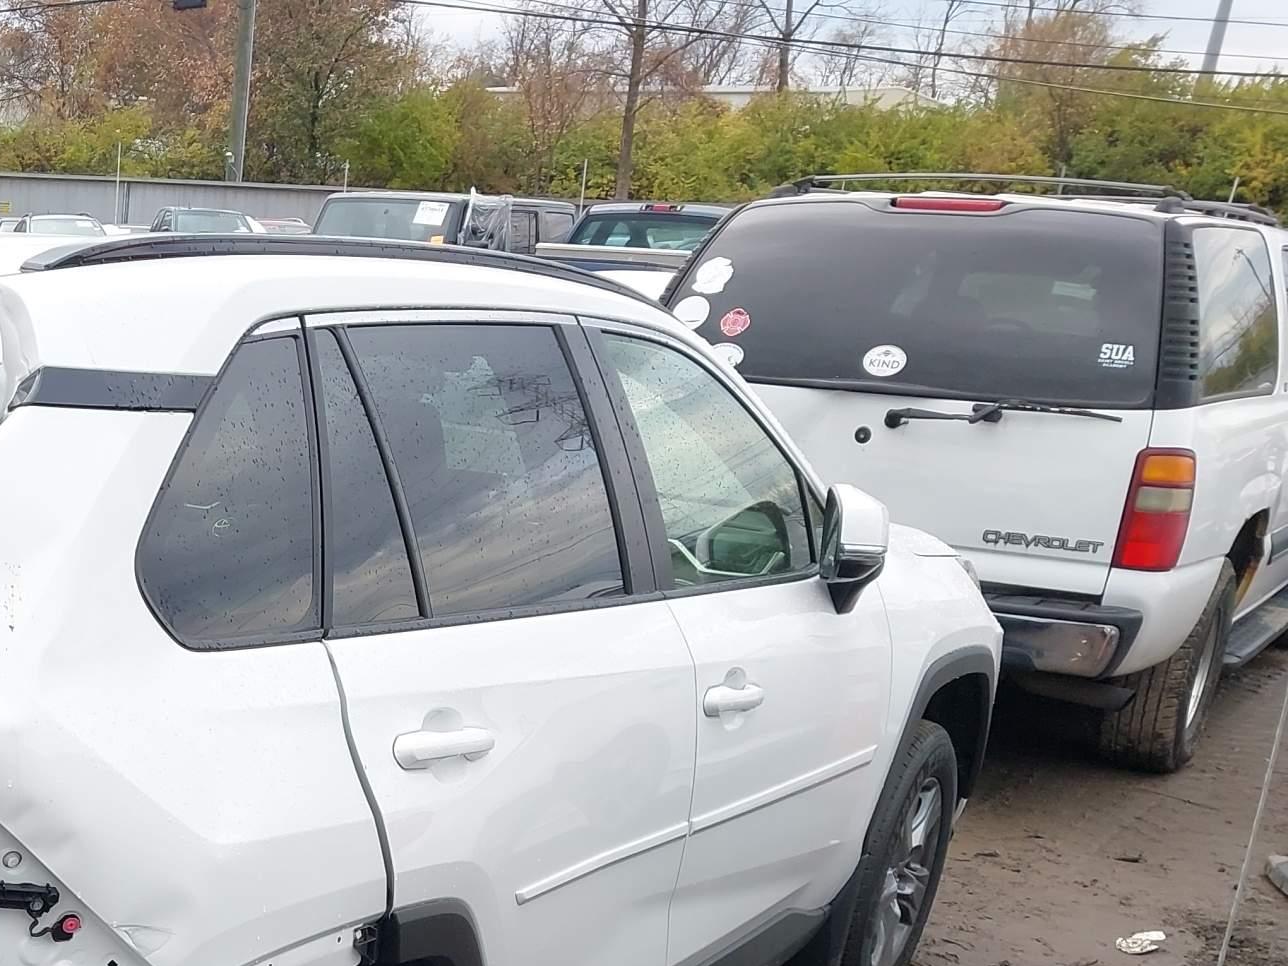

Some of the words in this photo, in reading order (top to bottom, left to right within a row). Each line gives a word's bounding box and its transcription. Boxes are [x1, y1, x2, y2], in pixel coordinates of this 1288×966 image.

[1099, 343, 1134, 361] SUA
[868, 358, 900, 369] KIND
[982, 529, 1105, 554] CHEVROLET
